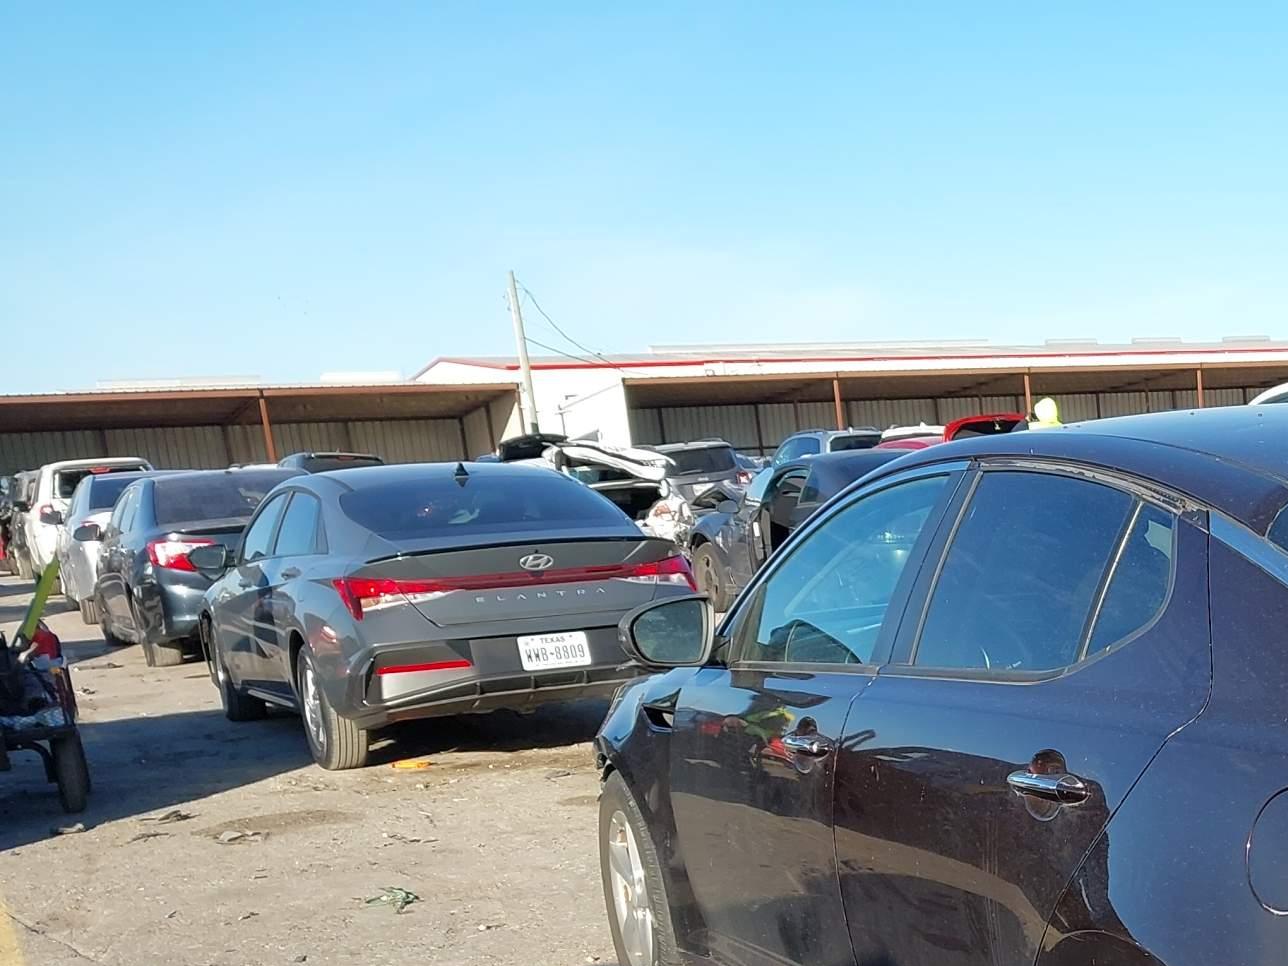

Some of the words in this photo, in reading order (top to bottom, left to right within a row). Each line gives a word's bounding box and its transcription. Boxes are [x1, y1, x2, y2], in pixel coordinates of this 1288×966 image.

[475, 587, 606, 603] ELANTRA
[540, 636, 566, 644] TEXAS
[525, 643, 585, 663] WWB-8809
